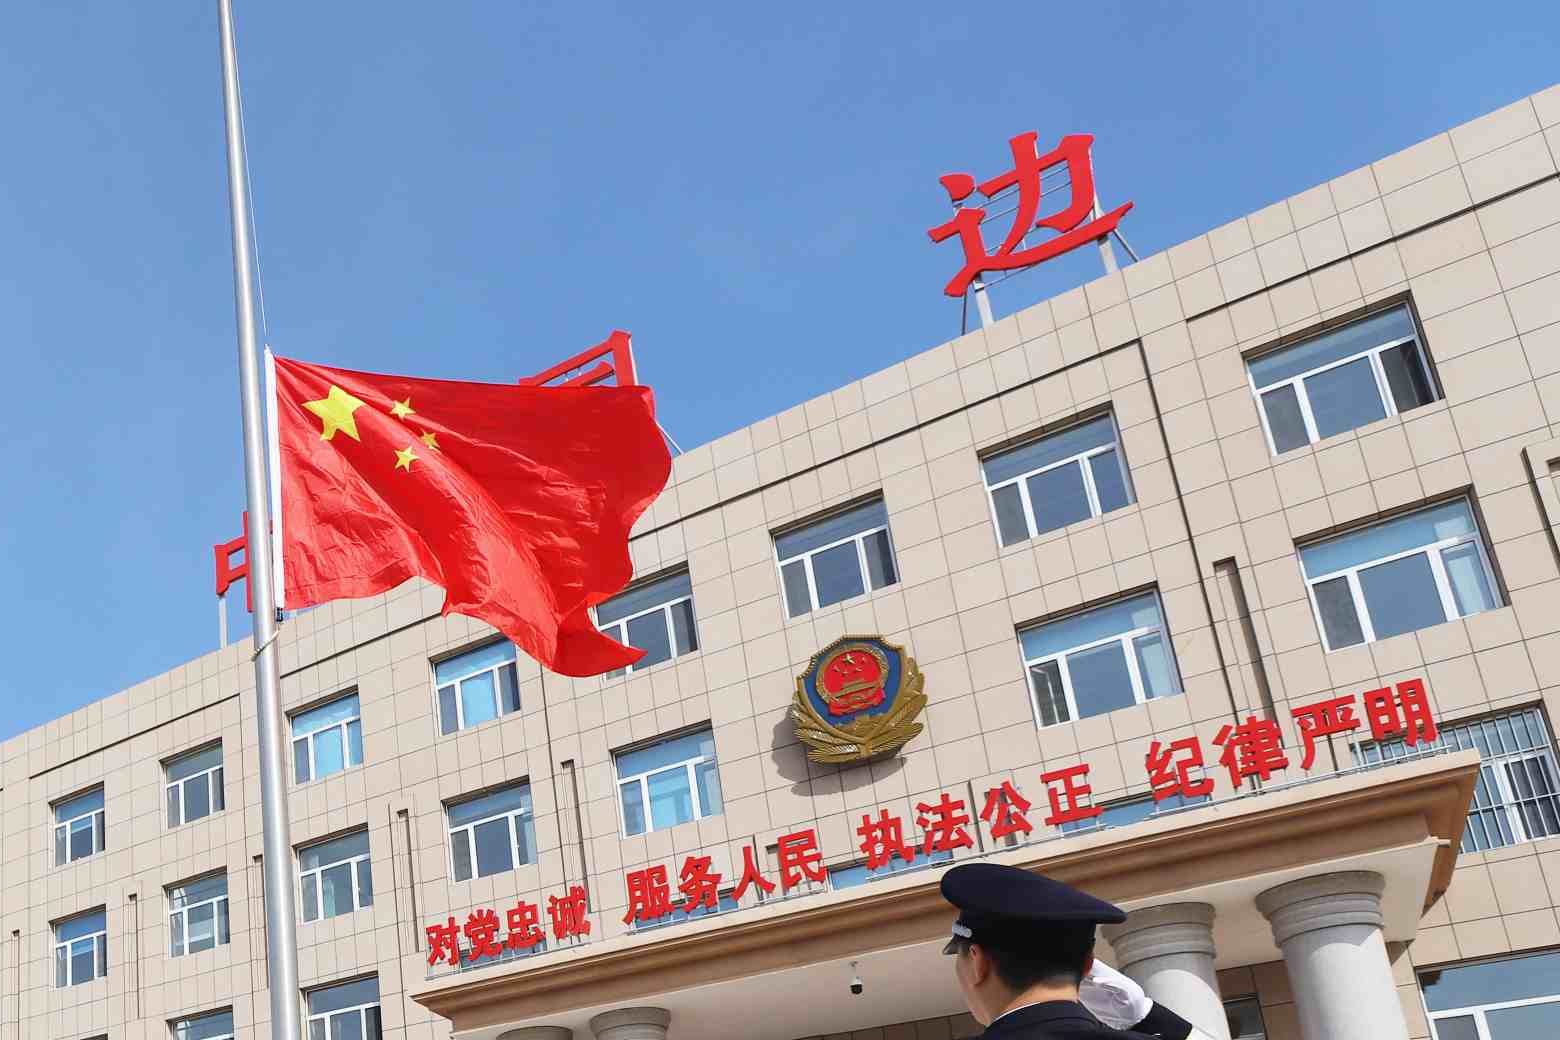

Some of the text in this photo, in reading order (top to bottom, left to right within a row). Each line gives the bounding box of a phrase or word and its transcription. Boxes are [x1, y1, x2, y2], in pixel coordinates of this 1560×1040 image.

[927, 130, 1134, 297] 边
[426, 678, 1438, 966] 对党忠诚 服务人民 执法公正 纪律严明
